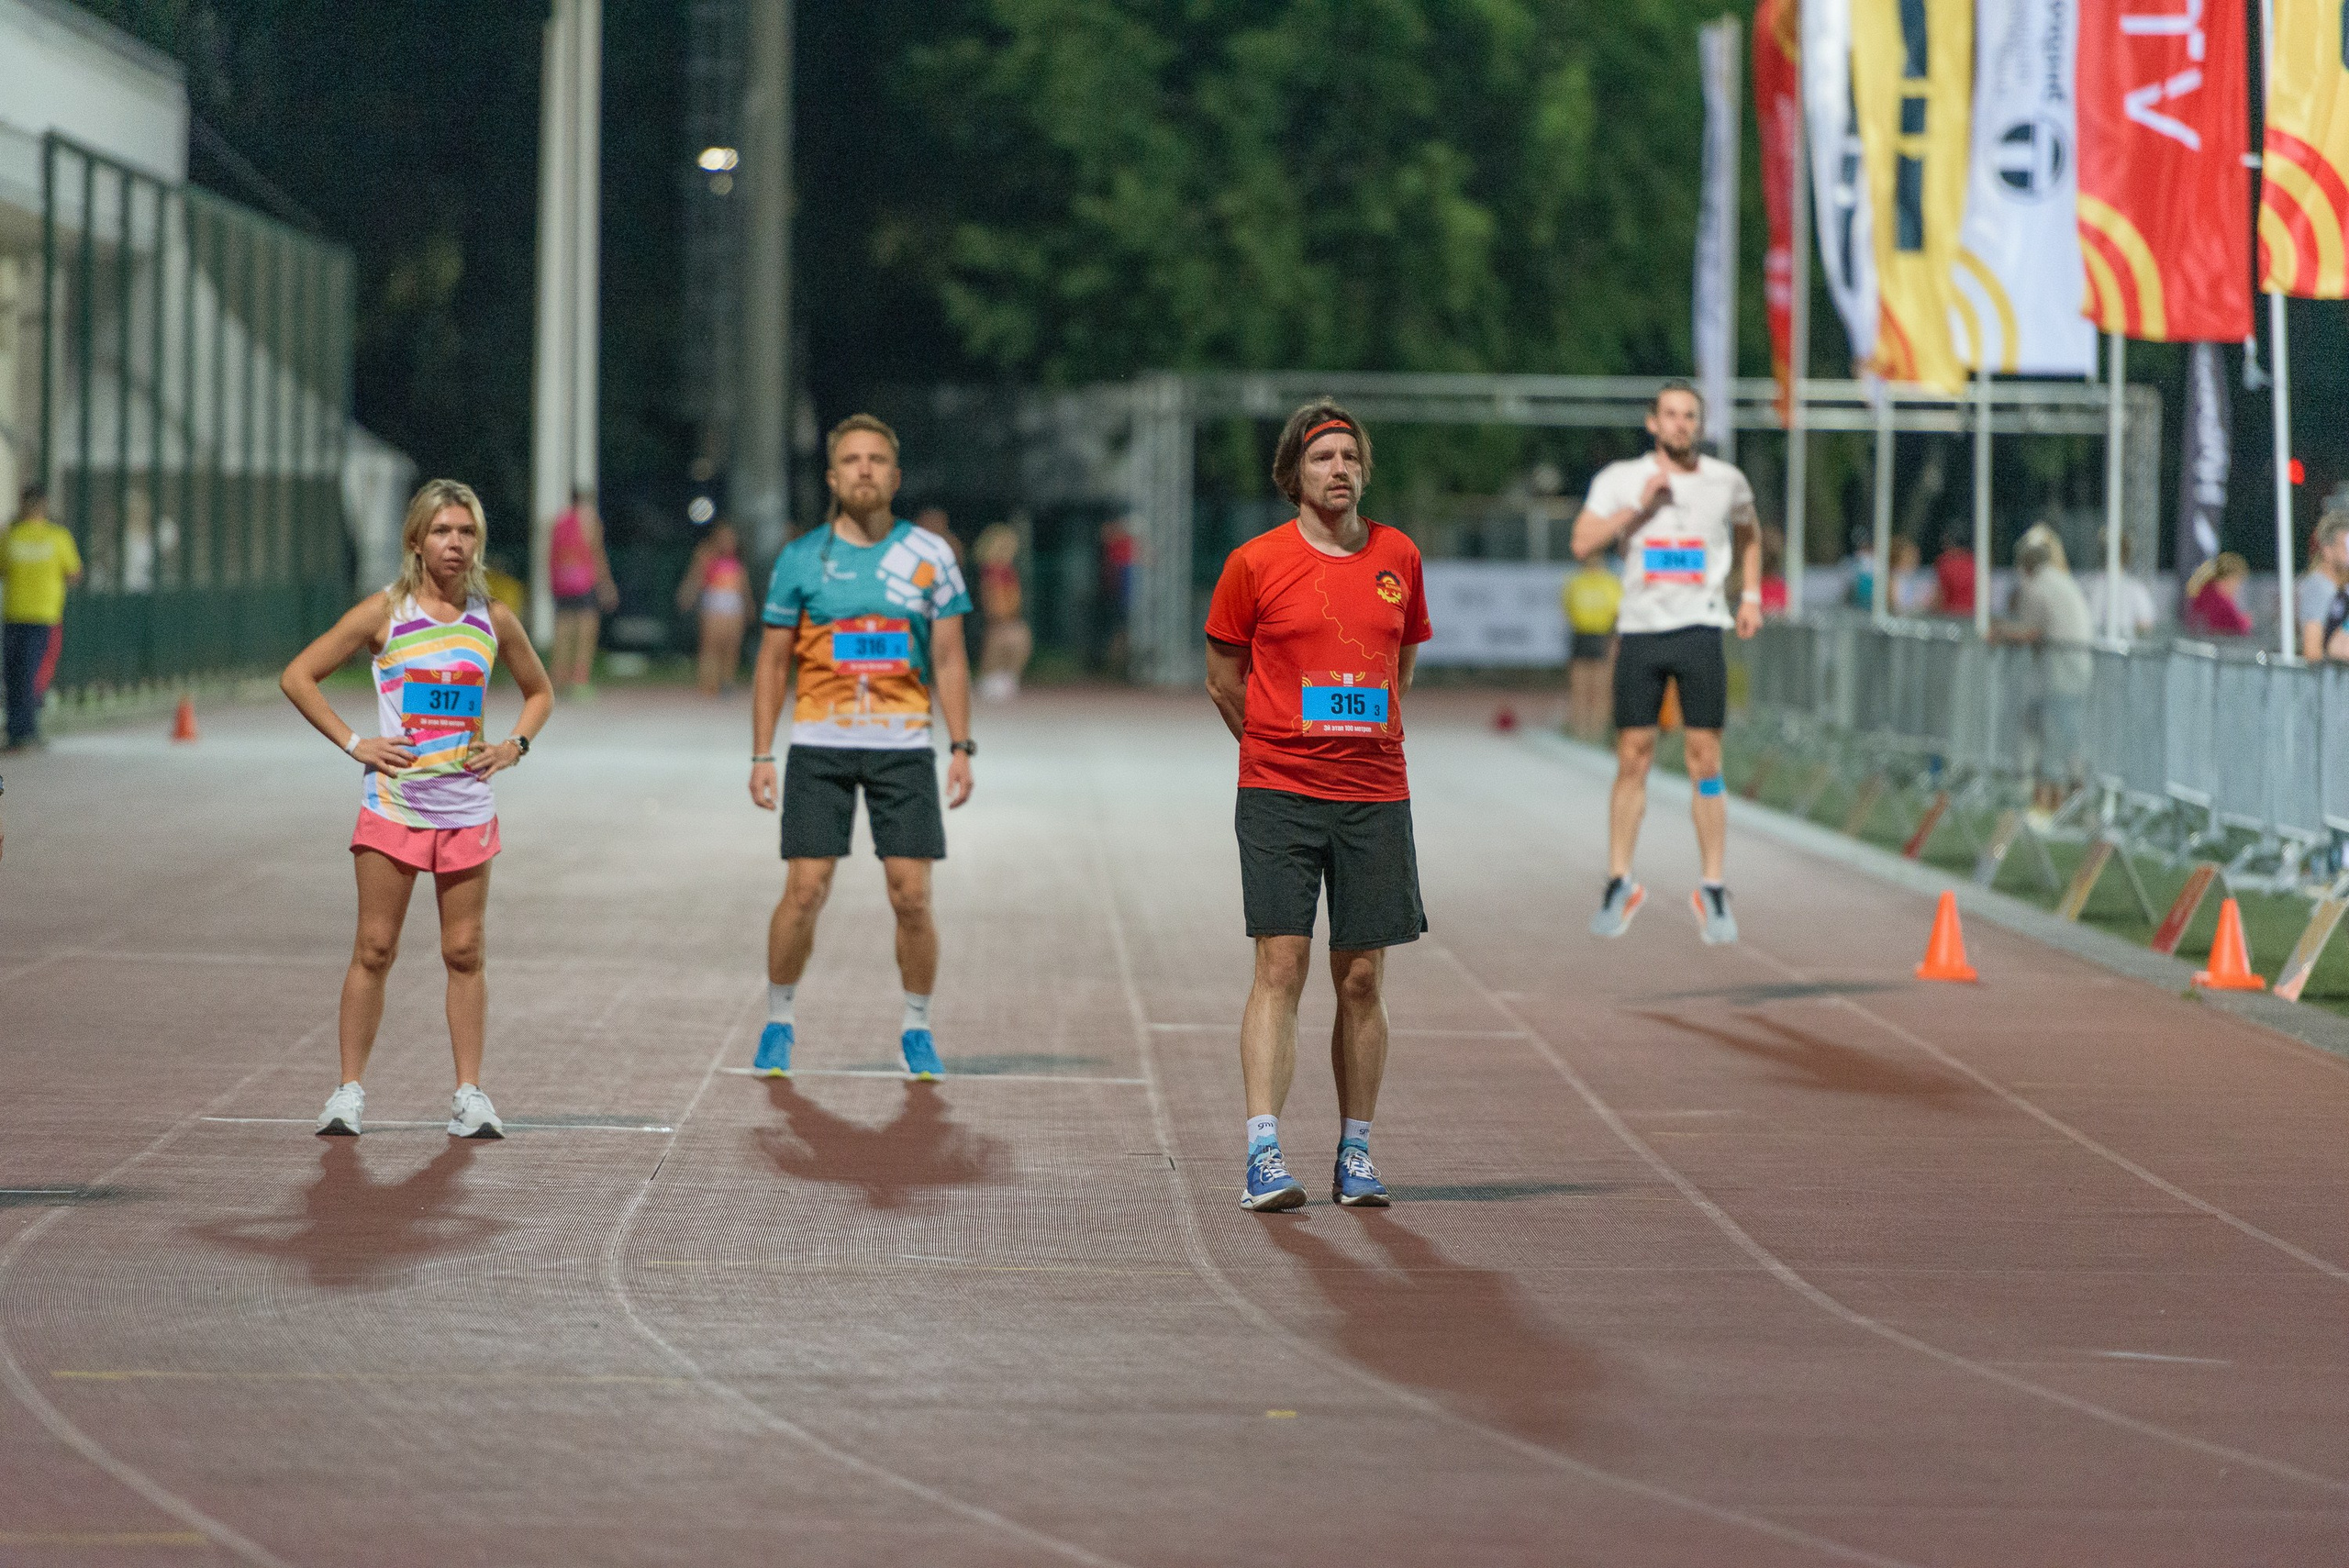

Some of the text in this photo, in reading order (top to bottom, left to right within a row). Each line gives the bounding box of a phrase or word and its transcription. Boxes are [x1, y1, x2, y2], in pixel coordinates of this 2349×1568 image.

[856, 637, 886, 655] 316
[429, 689, 475, 711] 317 3
[1330, 693, 1380, 716] 315 3
